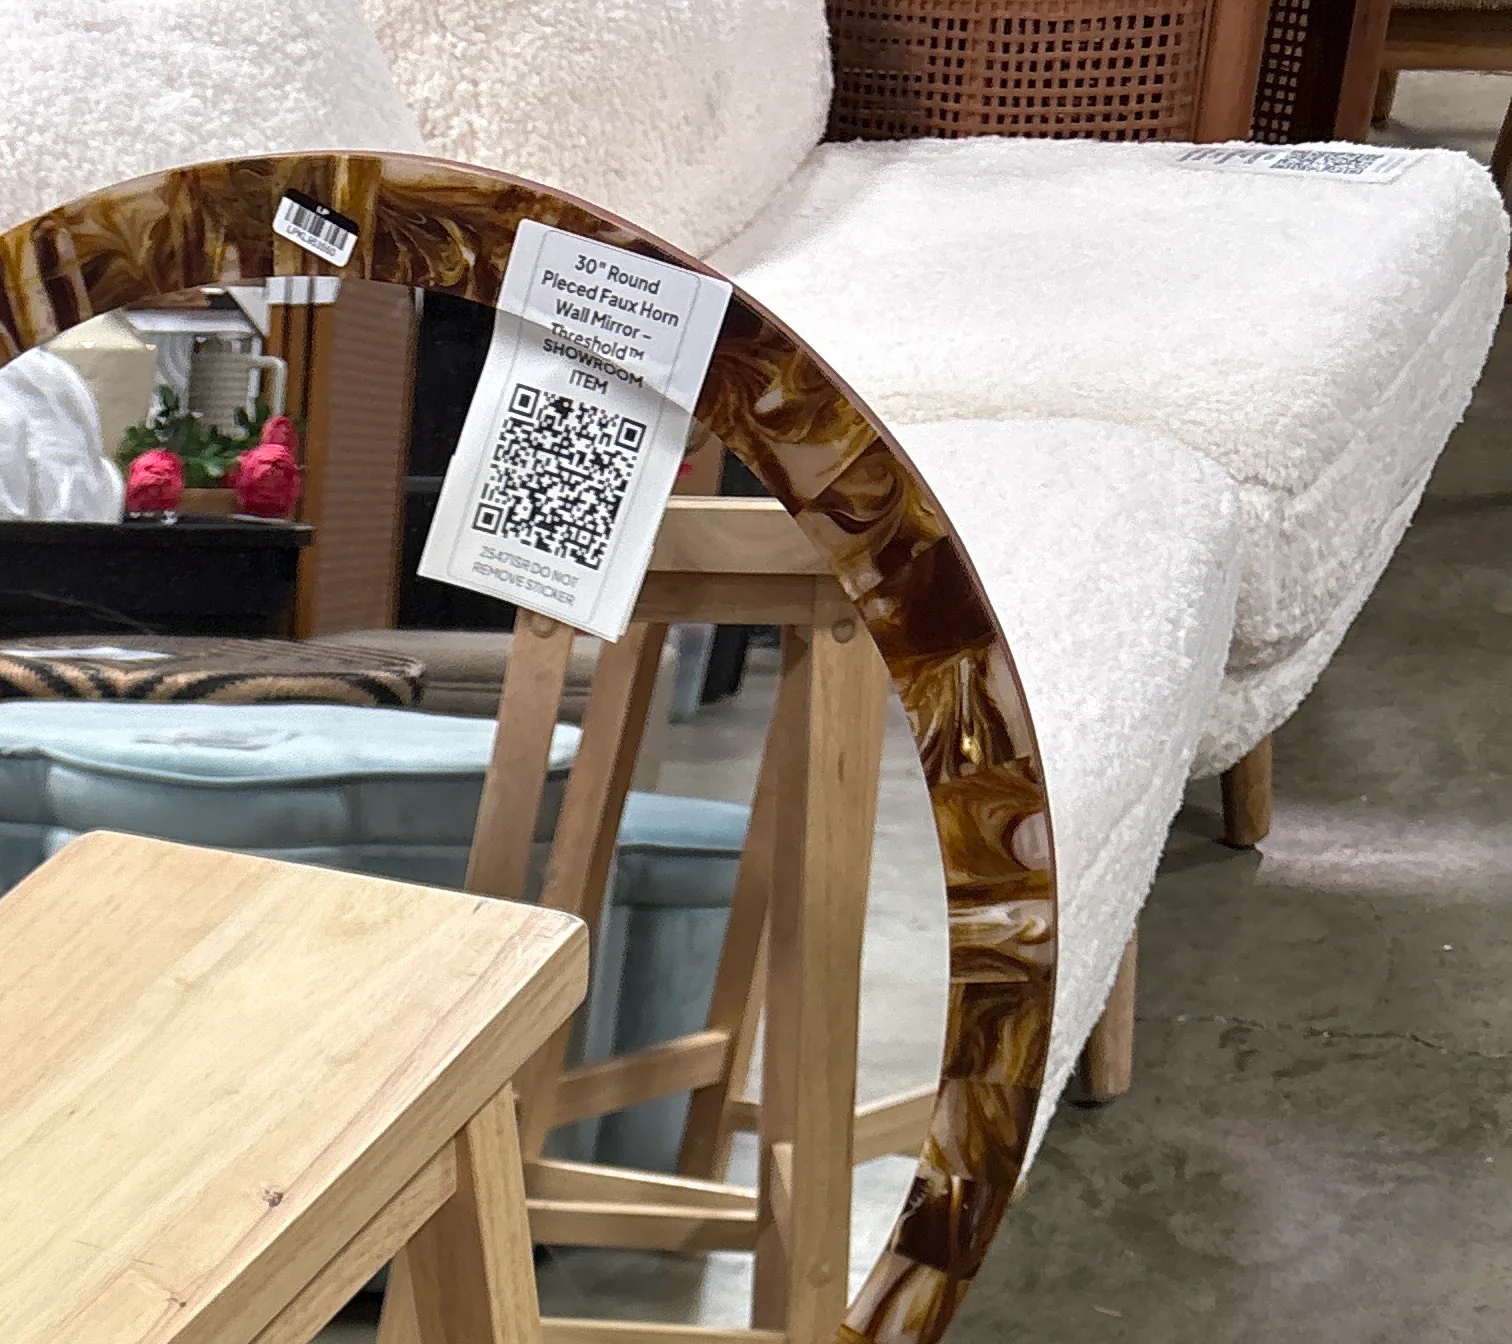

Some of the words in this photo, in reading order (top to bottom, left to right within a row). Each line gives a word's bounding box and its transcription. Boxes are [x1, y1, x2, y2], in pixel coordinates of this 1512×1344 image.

[574, 254, 606, 274] 30"
[607, 265, 661, 295] Round
[541, 270, 599, 300] Pieced
[599, 288, 638, 314] Faux
[639, 301, 679, 327] Horn
[556, 299, 590, 323] Wall
[590, 311, 640, 339] Mirror
[543, 338, 644, 388] SHOWROOM
[569, 369, 609, 395] ITEM
[472, 561, 525, 588] REMOVE
[525, 579, 575, 606] STICKER
[530, 562, 551, 578] DO
[552, 570, 580, 588] NOT
